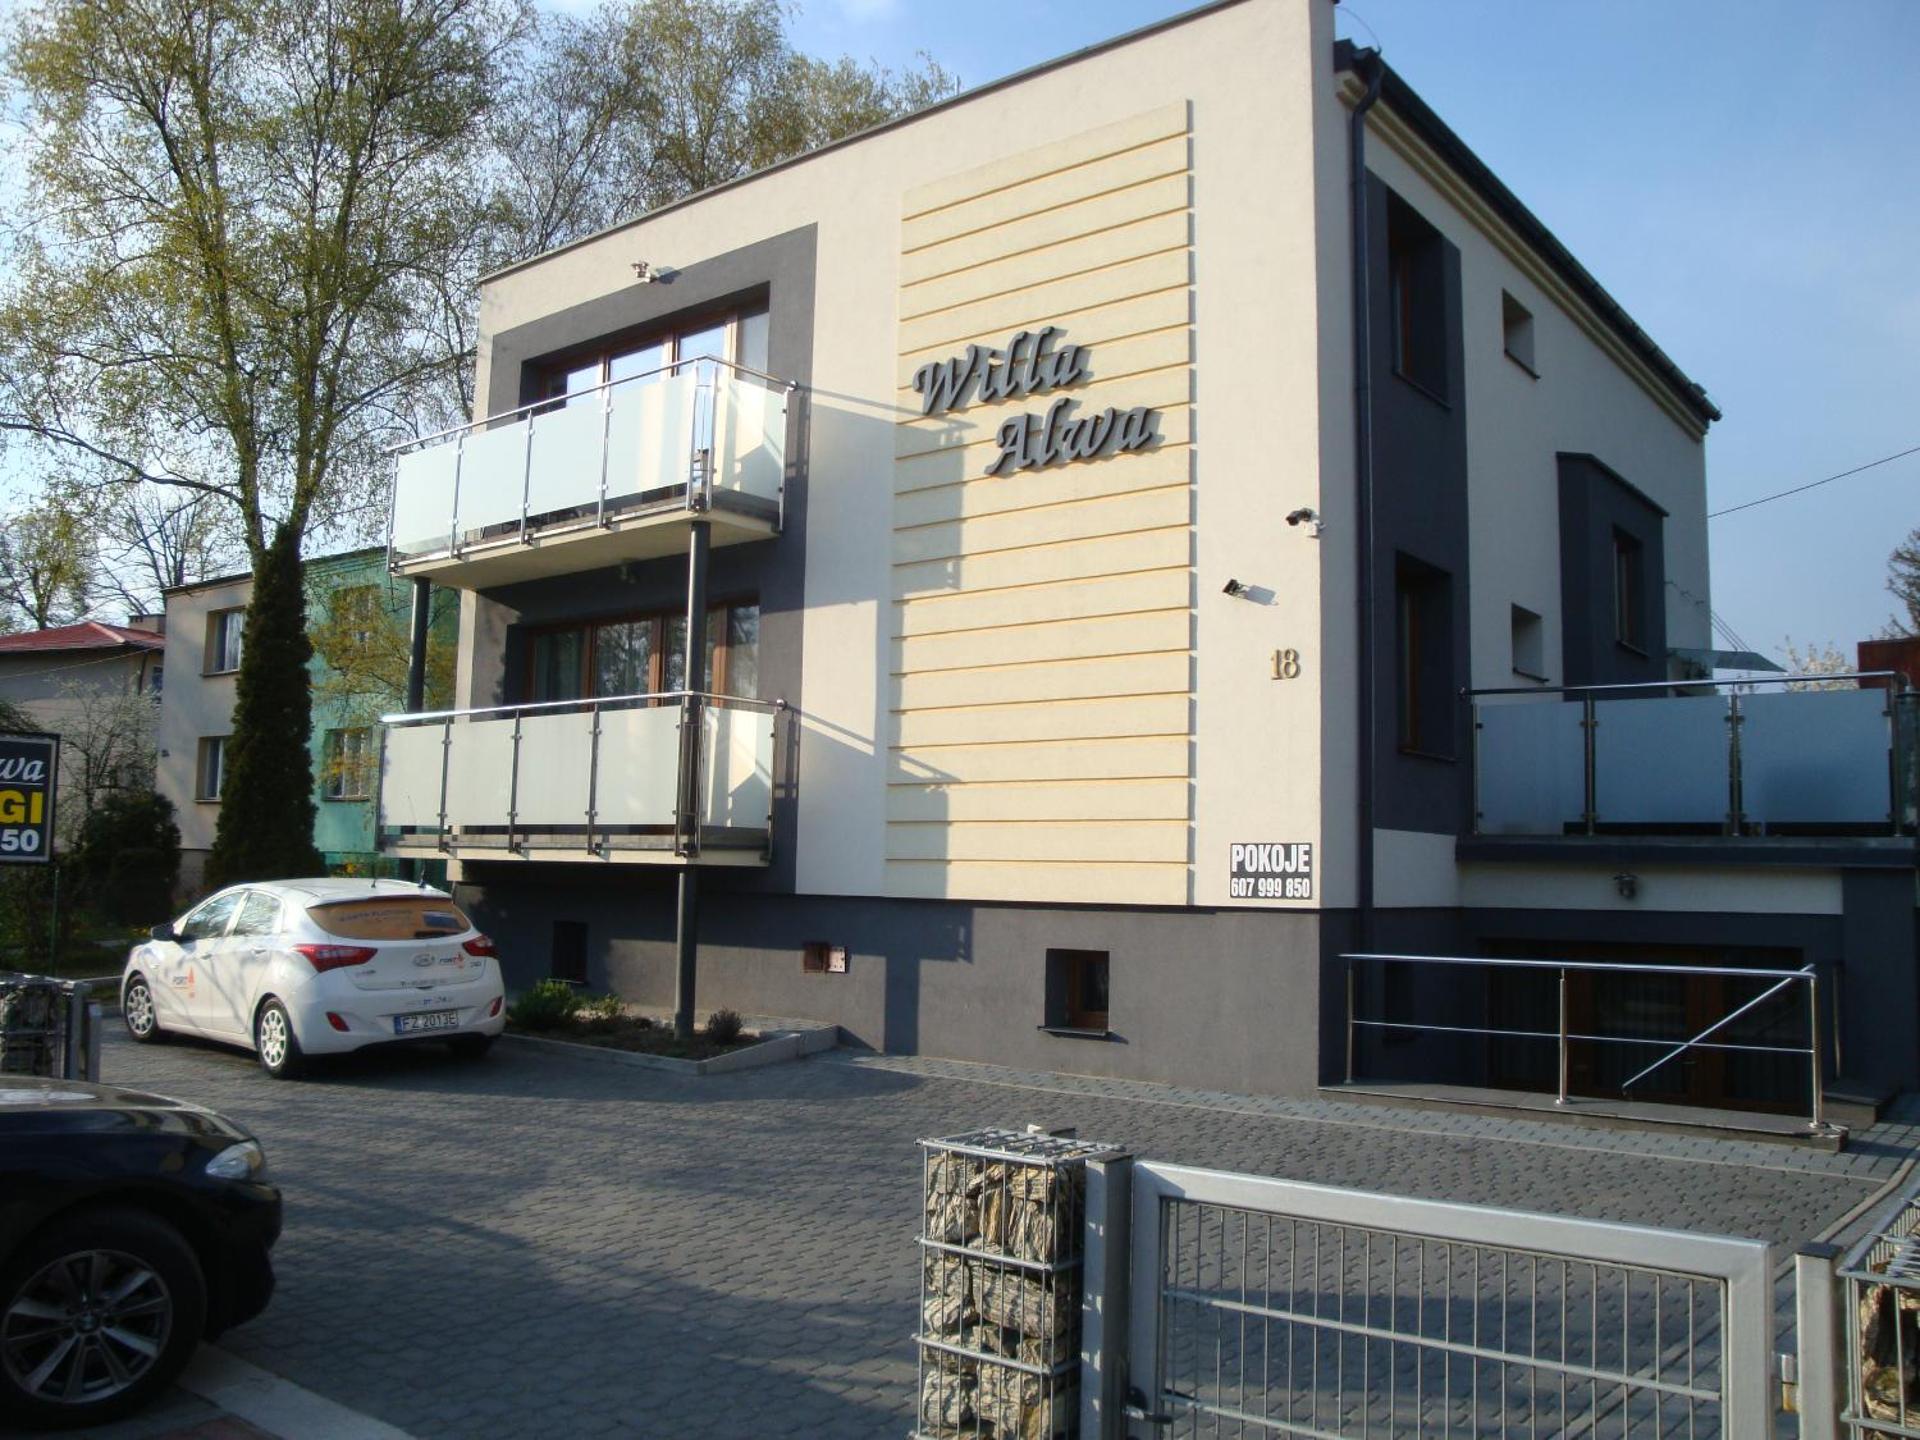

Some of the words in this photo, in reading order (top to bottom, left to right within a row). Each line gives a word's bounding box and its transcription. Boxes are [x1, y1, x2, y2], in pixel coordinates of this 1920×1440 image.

[912, 326, 1082, 416] Willa
[984, 398, 1153, 475] Alwa
[1271, 648, 1300, 680] 18
[1231, 844, 1310, 873] POKOJE
[1231, 877, 1255, 897] 607
[1258, 877, 1282, 897] 999
[1285, 877, 1310, 898] 850
